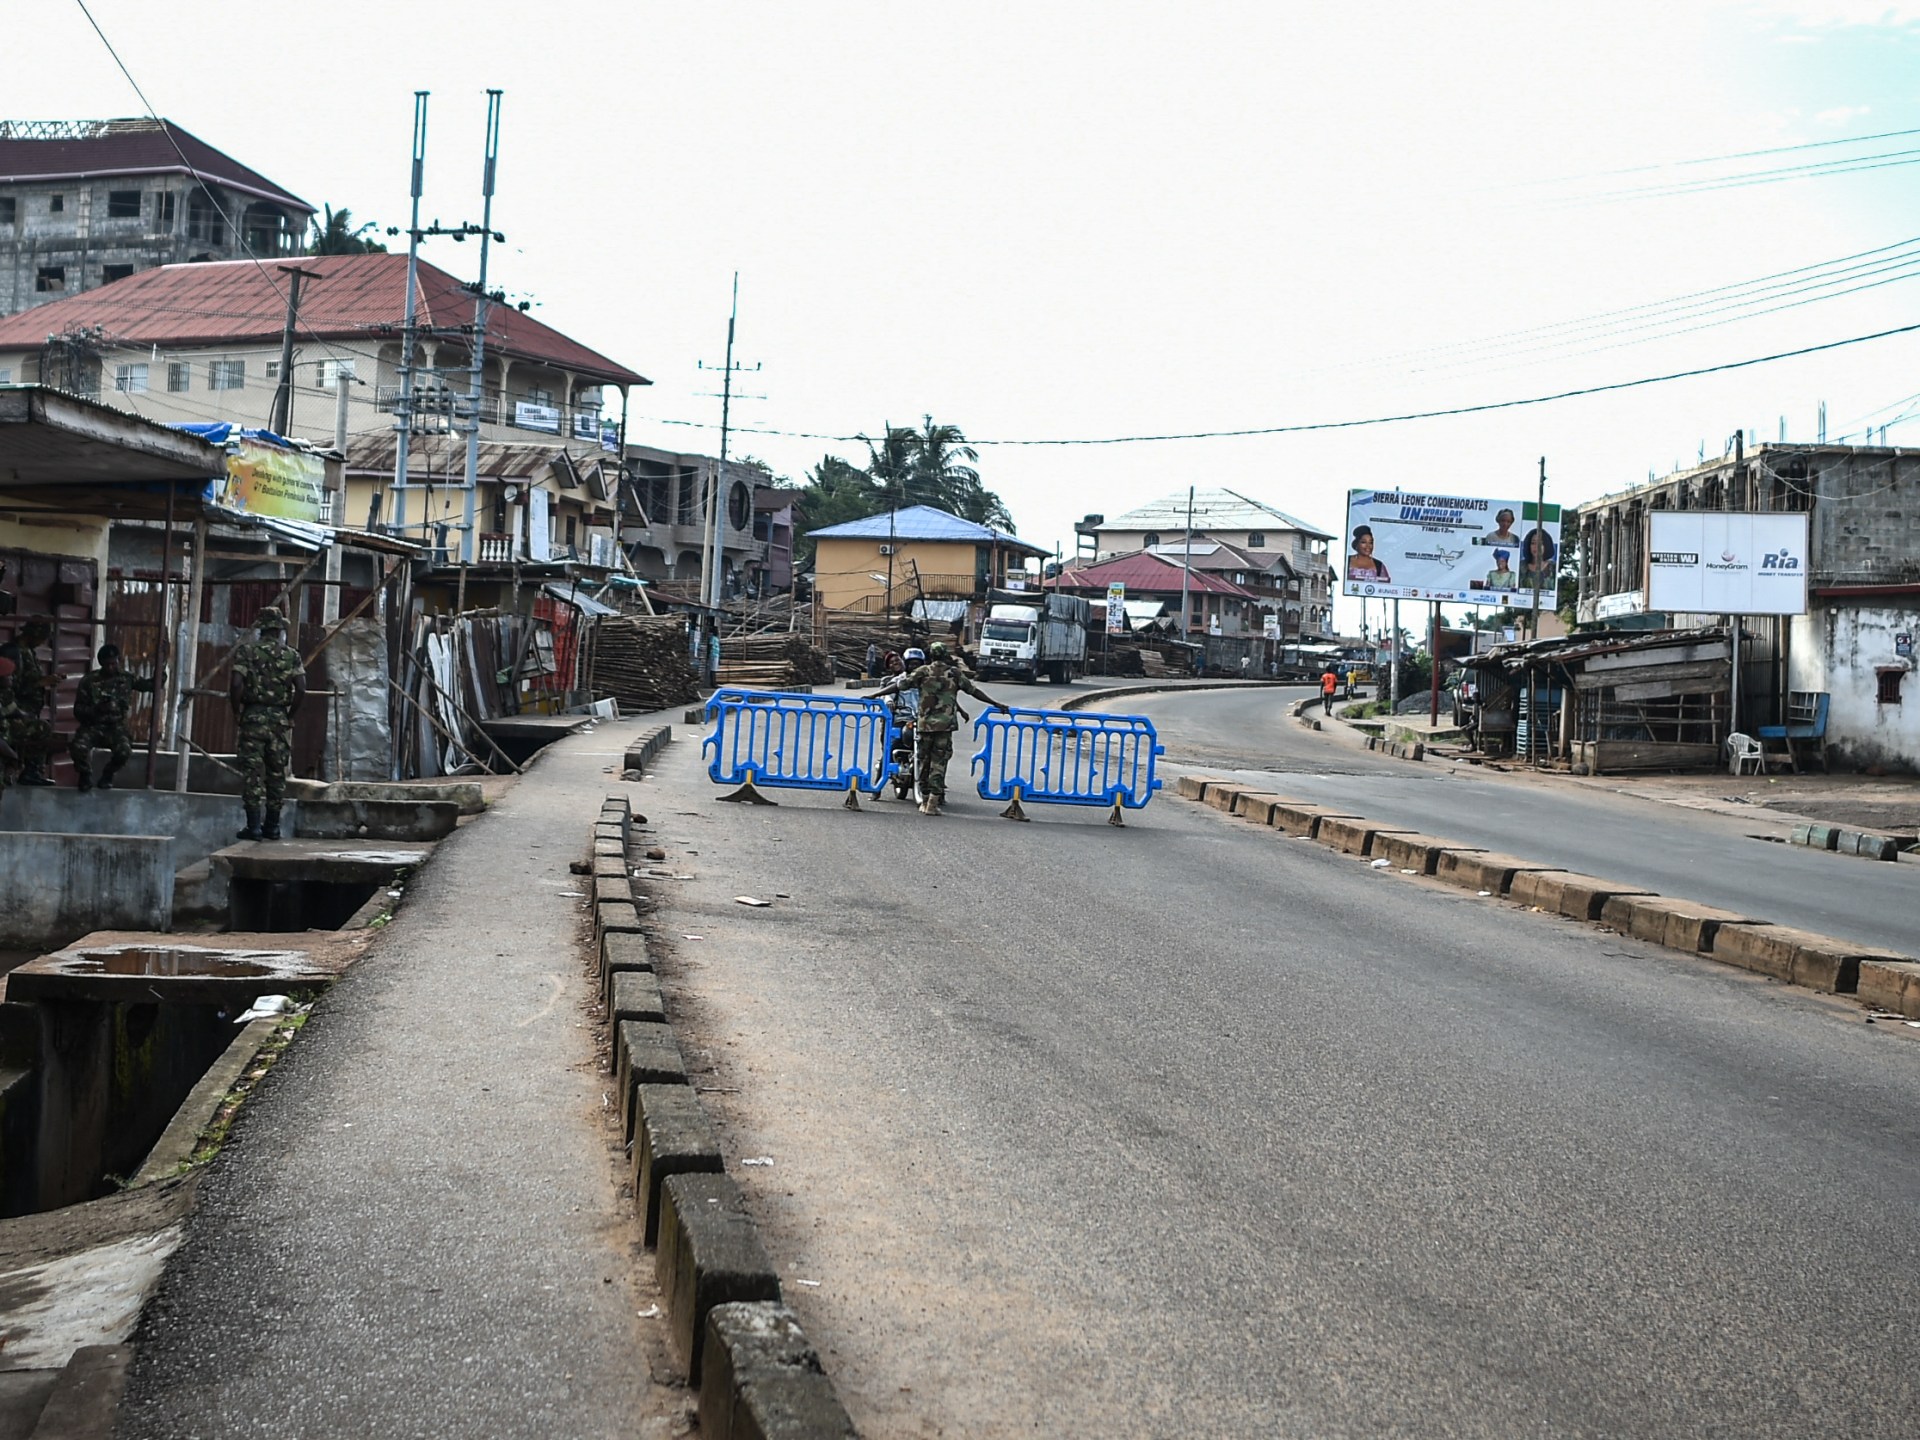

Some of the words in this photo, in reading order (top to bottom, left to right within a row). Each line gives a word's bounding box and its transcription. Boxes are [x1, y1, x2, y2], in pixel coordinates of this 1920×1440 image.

[1372, 492, 1399, 504] SIERRA
[1401, 494, 1426, 507] LEONE
[1427, 496, 1489, 511] COMMEMORATES
[1400, 506, 1422, 520] UN
[1422, 508, 1448, 516] WORLD
[1420, 515, 1454, 523] NOVEMBER
[1762, 548, 1799, 569] Ria
[1705, 562, 1748, 570] MoneyGram
